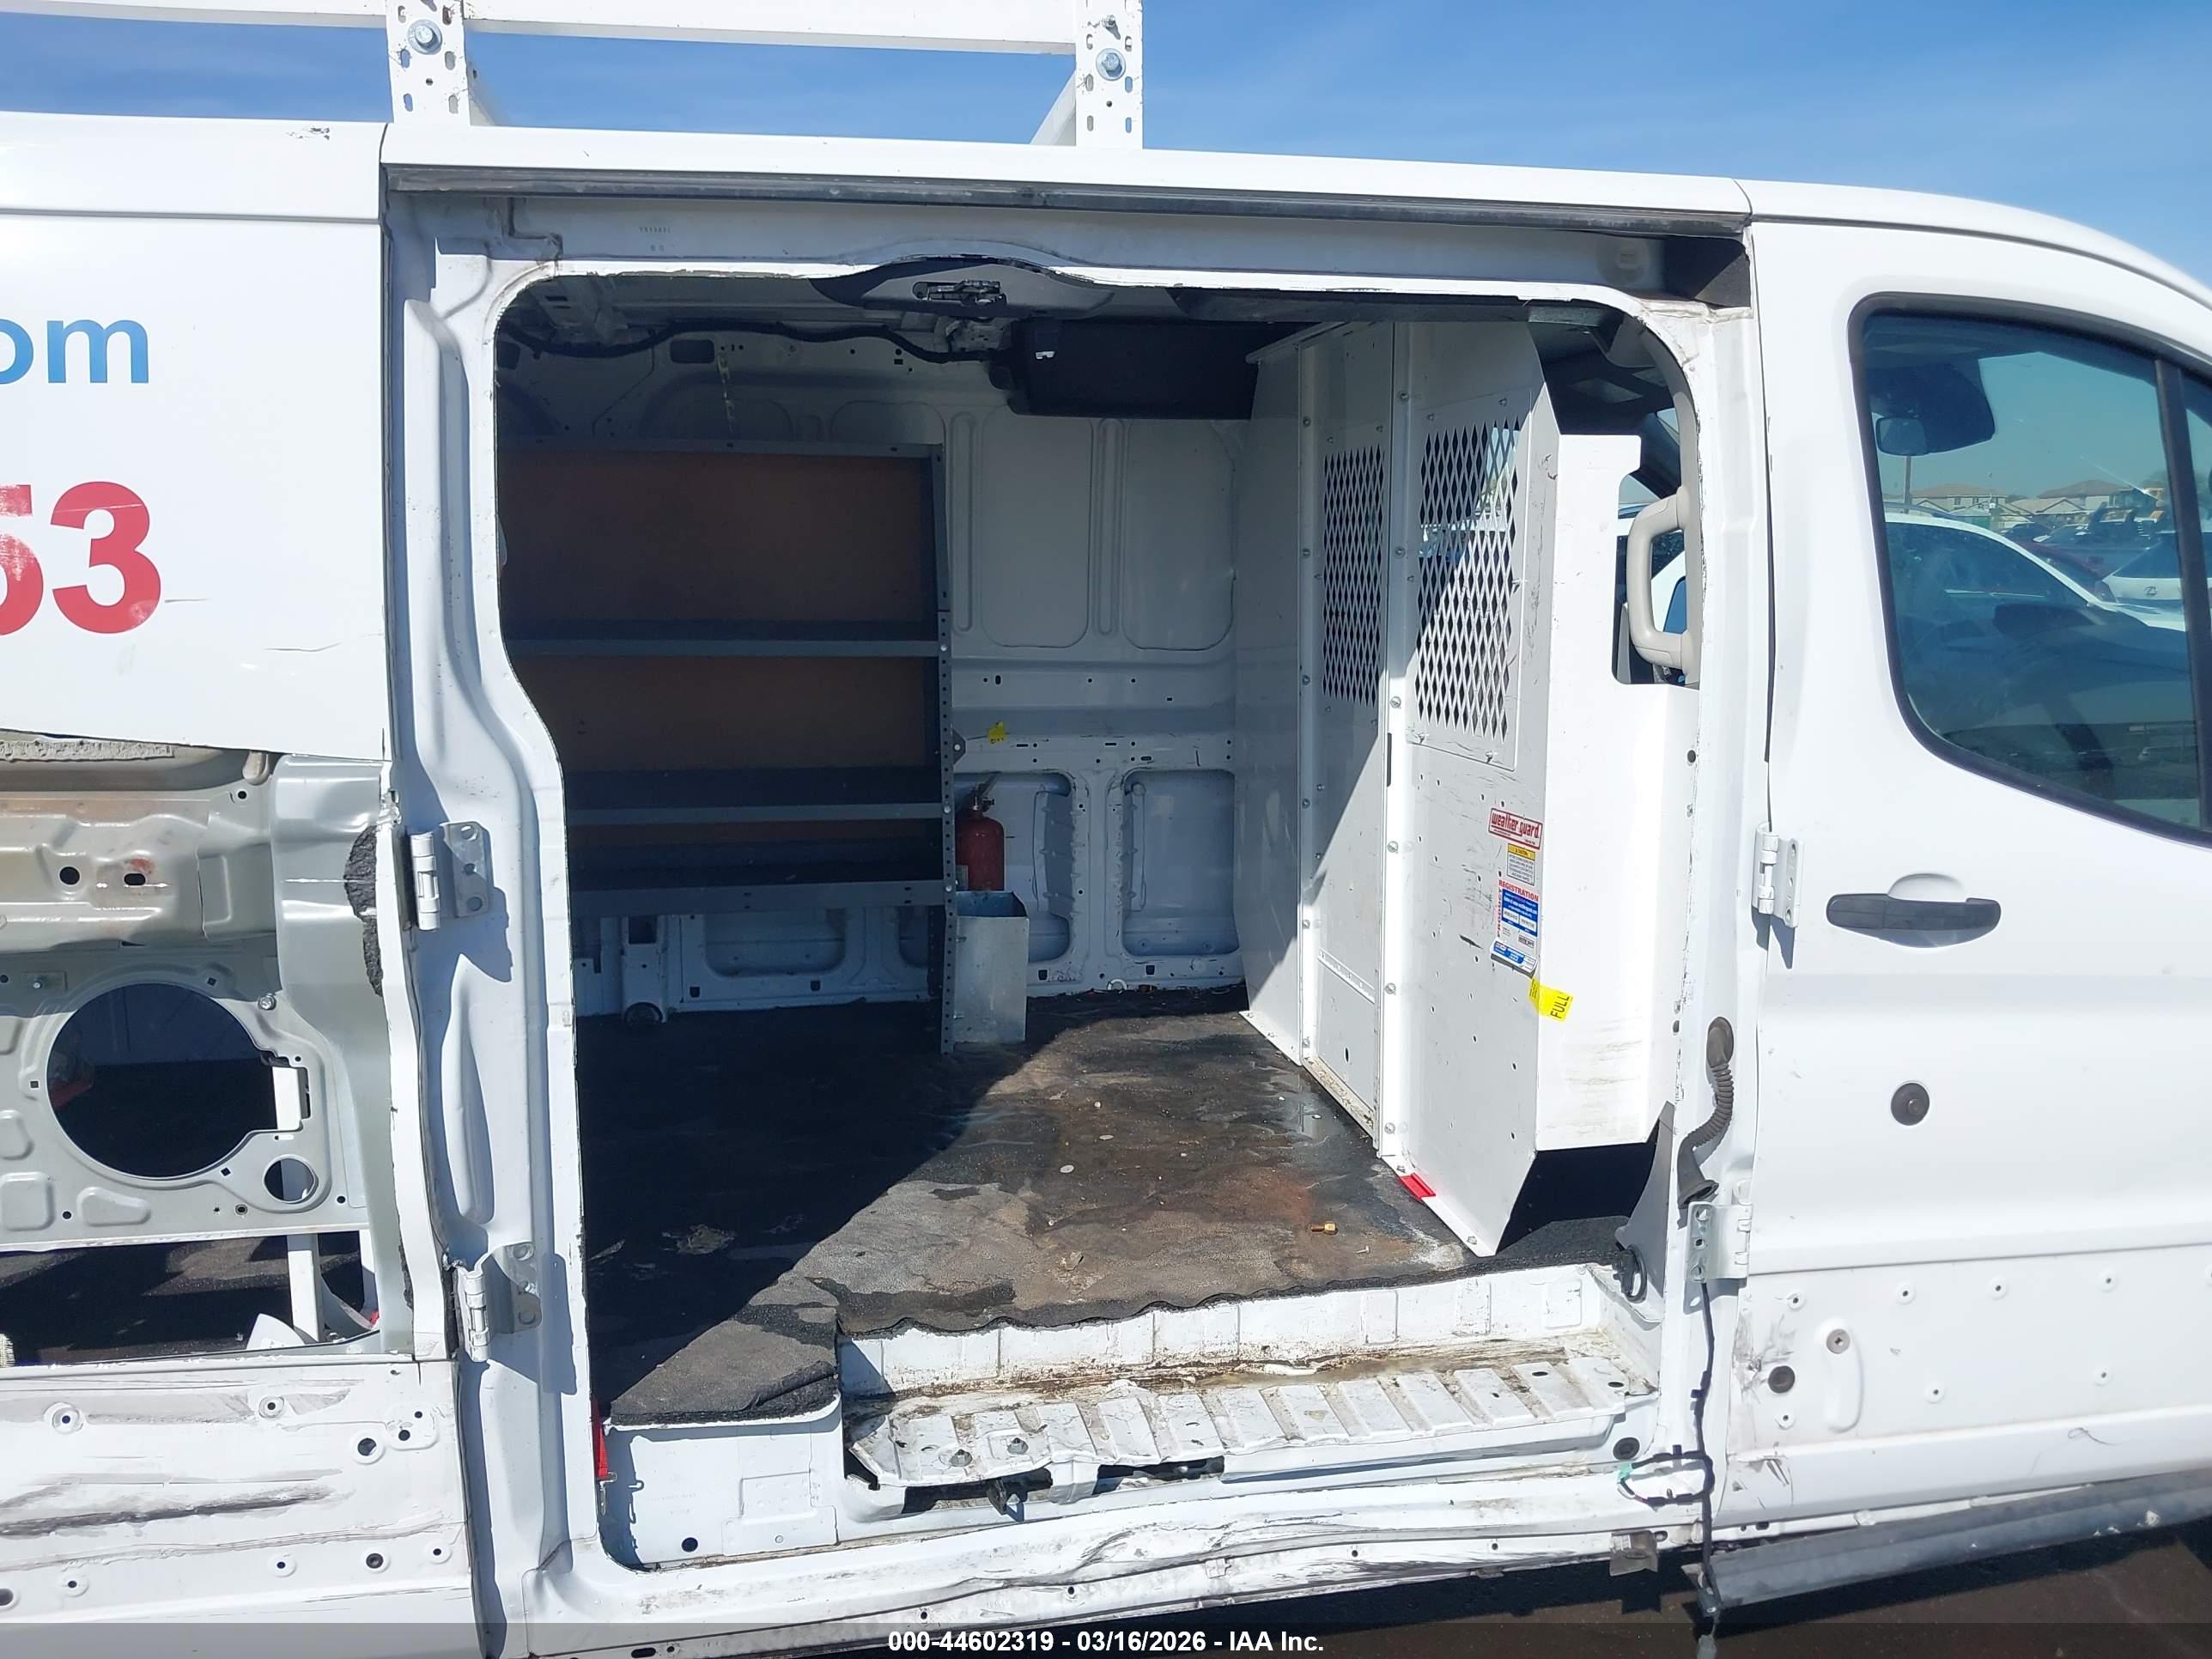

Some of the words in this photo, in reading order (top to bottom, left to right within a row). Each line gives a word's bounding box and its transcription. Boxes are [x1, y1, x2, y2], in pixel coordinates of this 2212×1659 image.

[1492, 812, 1519, 831] weather
[1498, 879, 1540, 902] REGISTRATION
[1549, 995, 1570, 1019] FULL
